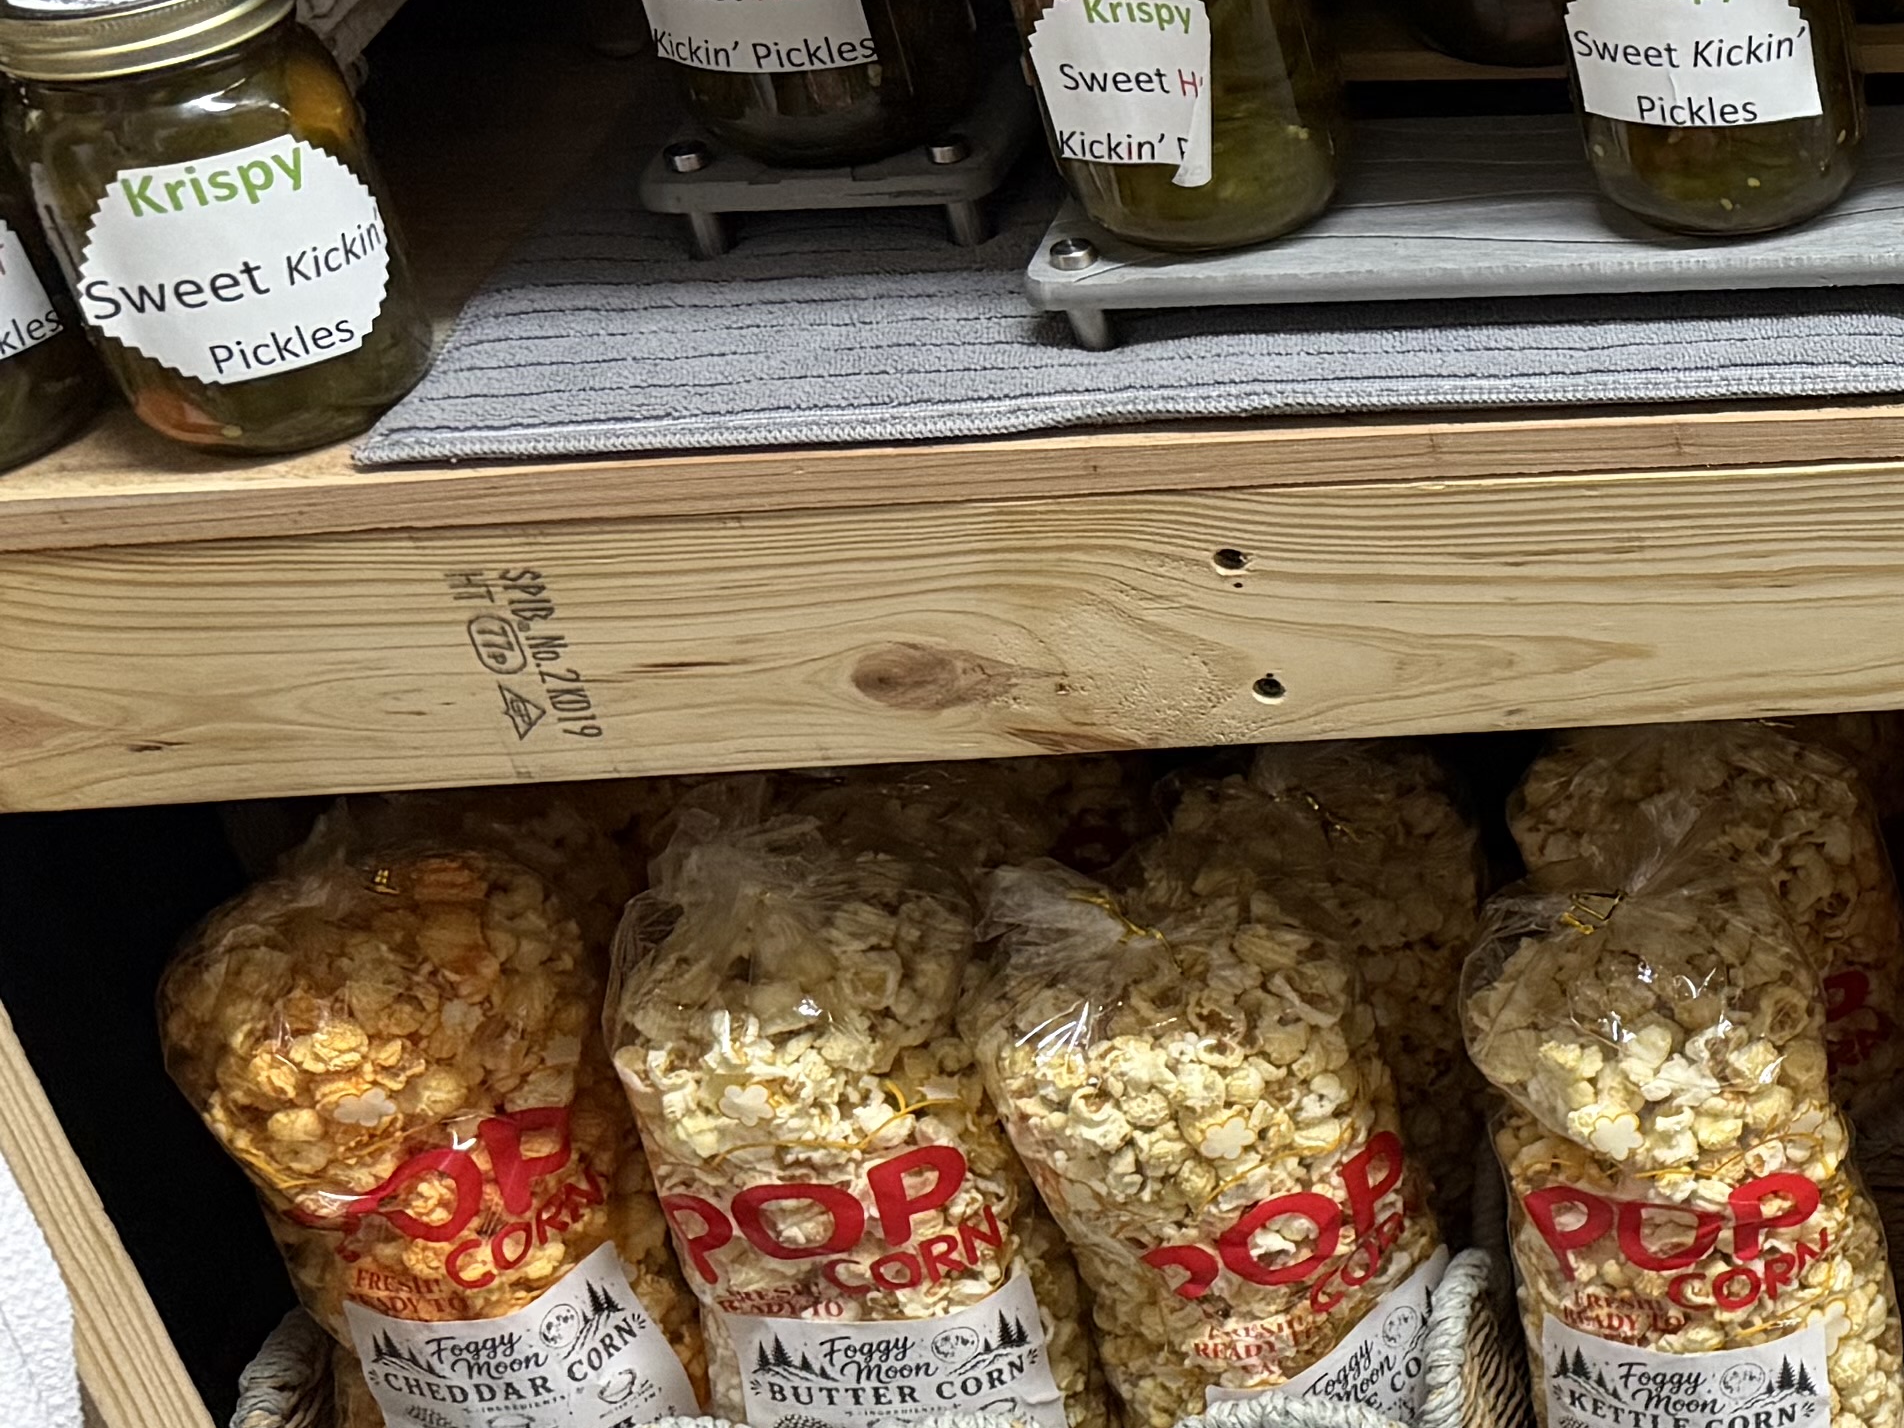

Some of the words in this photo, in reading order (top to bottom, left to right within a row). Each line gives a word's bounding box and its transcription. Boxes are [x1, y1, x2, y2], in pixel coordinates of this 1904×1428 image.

[751, 35, 877, 68] Pickles
[1572, 30, 1678, 69] Sweet
[1060, 63, 1171, 95] Sweet
[1636, 95, 1759, 126] Pickles
[121, 147, 302, 217] Krispy
[85, 261, 271, 321] Sweet
[209, 319, 355, 374] Pickles
[546, 686, 603, 738] KD19
[660, 1144, 967, 1285] POP
[1523, 1172, 1821, 1282] POP
[823, 1204, 1004, 1295] CORN
[1667, 1227, 1830, 1312] CORN
[384, 1370, 555, 1404] CHEDDAR
[567, 1317, 638, 1381] CORN
[819, 1336, 915, 1364] Foggy
[840, 1359, 939, 1384] Moon
[767, 1379, 922, 1405] BUTTER
[936, 1353, 1026, 1400] CORN
[1618, 1362, 1708, 1394] Foggy
[1631, 1388, 1728, 1415] Moon
